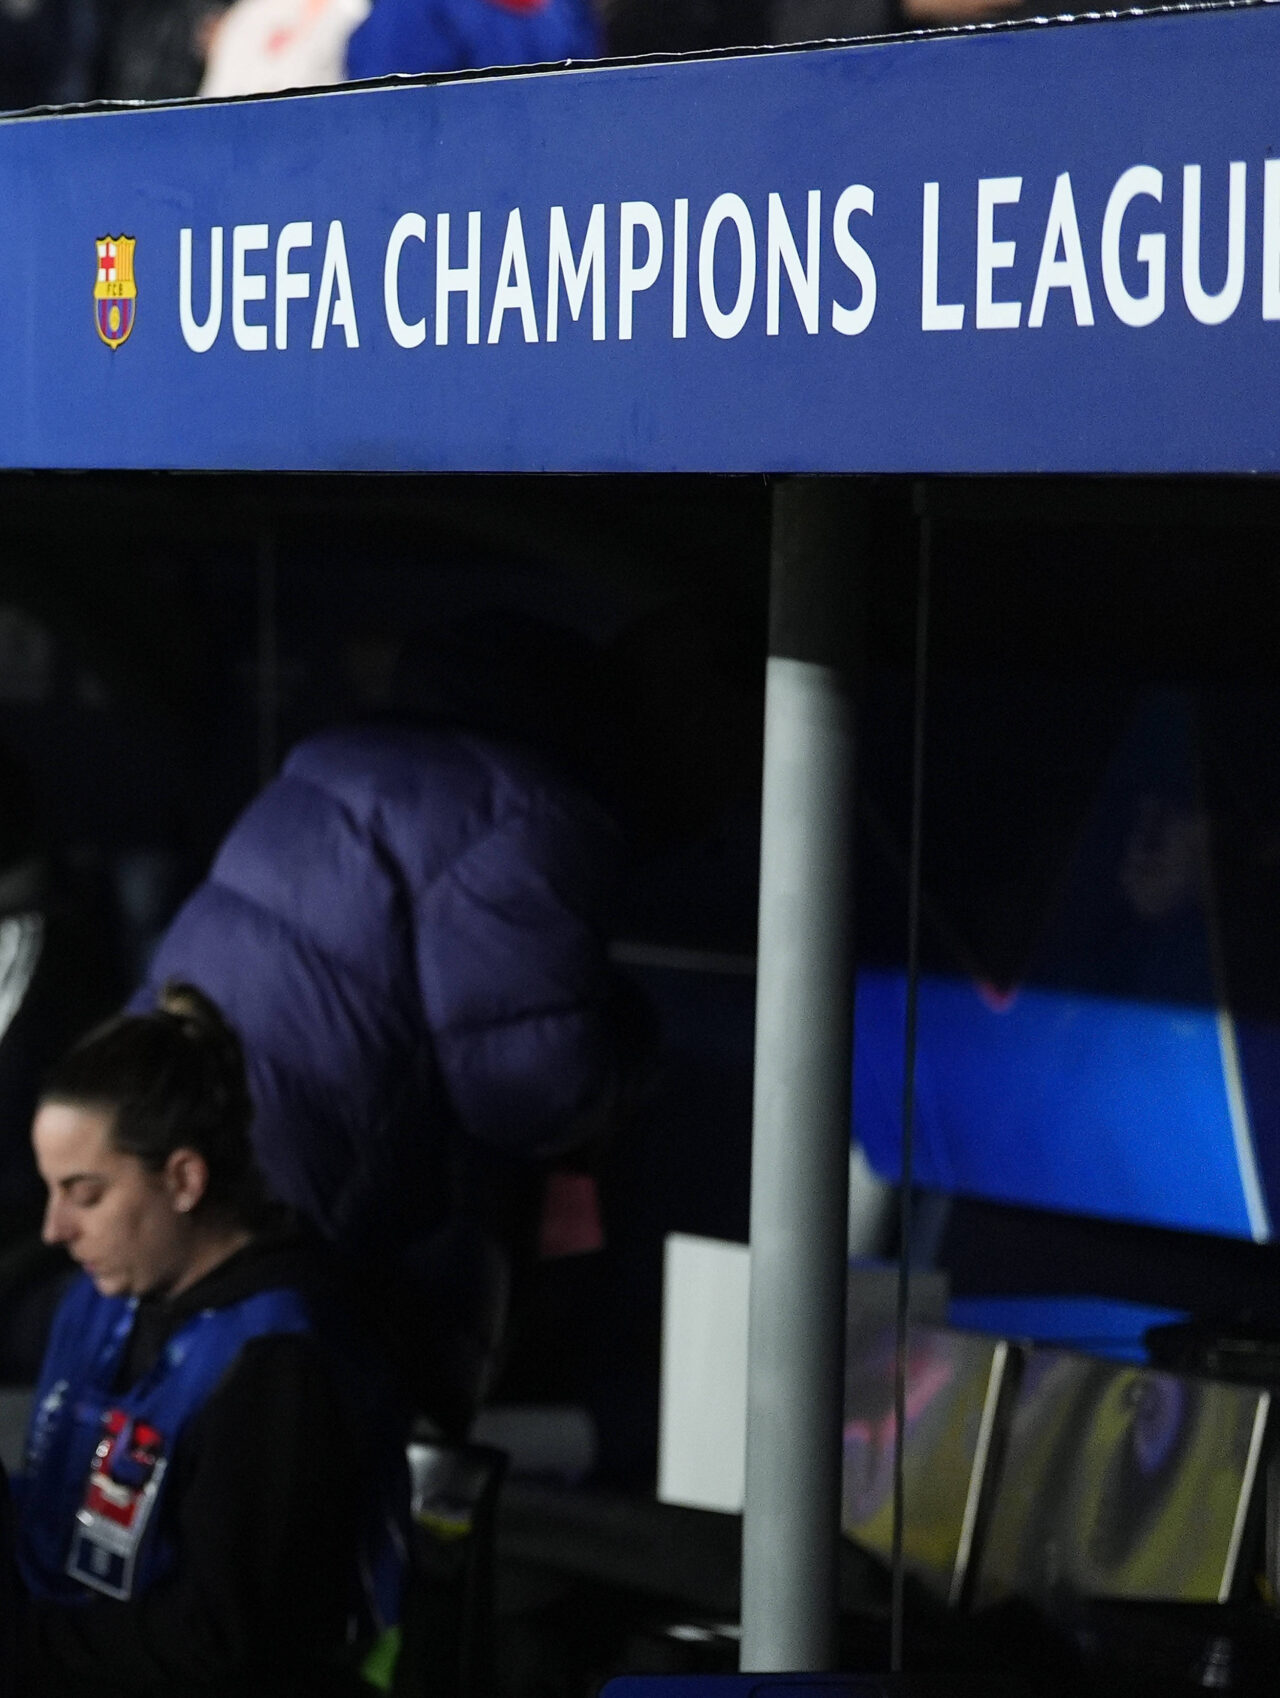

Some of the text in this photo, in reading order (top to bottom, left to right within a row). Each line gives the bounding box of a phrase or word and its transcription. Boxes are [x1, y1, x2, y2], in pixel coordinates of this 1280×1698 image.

[107, 283, 123, 296] FCB
[180, 220, 359, 353] UEFA
[385, 185, 876, 348] CHAMPIONS
